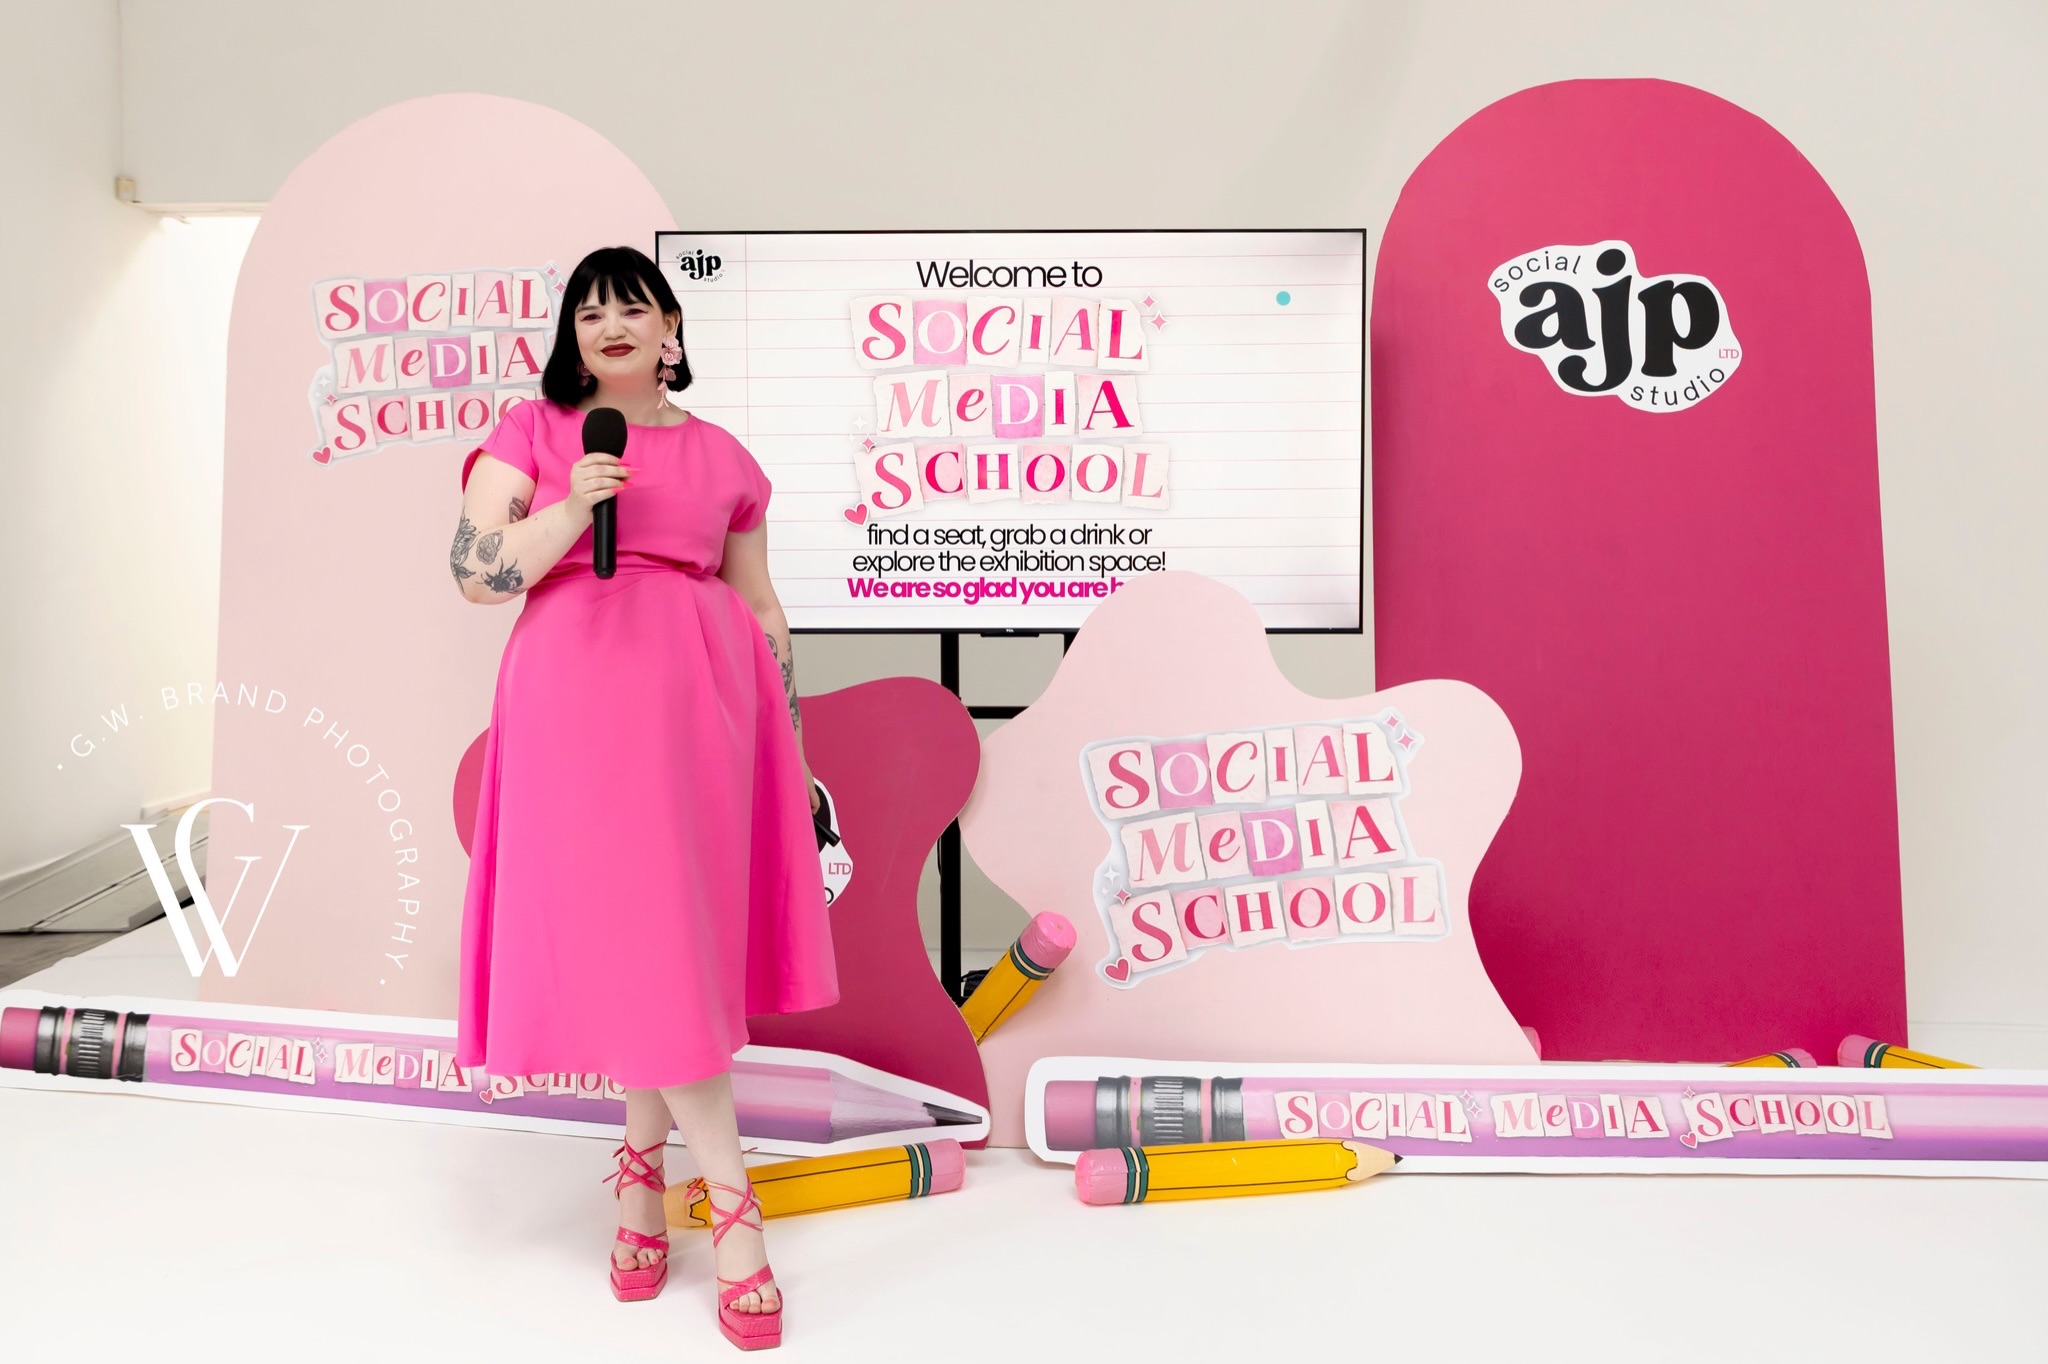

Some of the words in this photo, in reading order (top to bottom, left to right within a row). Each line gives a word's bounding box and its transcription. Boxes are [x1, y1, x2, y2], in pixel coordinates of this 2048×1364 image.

[680, 249, 722, 280] ajp
[916, 259, 1067, 288] Welcome
[1071, 261, 1103, 288] to
[1493, 250, 1582, 293] social
[325, 278, 549, 332] SOCIAL
[1514, 248, 1720, 393] ajp
[862, 302, 1143, 361] SOCIAL
[1718, 348, 1740, 359] LTD
[1630, 368, 1725, 406] studio
[333, 395, 528, 451] SCHO
[871, 451, 1164, 510] SCHOOL
[867, 523, 909, 545] find
[913, 528, 929, 545] a
[933, 525, 987, 549] seat,
[990, 523, 1046, 553] grab
[1050, 528, 1066, 545] a
[1070, 523, 1126, 545] drink
[1129, 528, 1153, 545] or
[852, 550, 935, 579] explore
[938, 550, 976, 572] the
[979, 549, 1085, 572] exhibition
[1089, 551, 1166, 579] space!
[847, 577, 889, 598] We
[890, 581, 931, 598] are
[933, 581, 962, 598] so
[963, 576, 1017, 606] glad
[1019, 581, 1066, 605] you
[1067, 581, 1108, 598] are
[1105, 731, 1394, 809] SOCIAL
[828, 862, 852, 875] LTD
[1131, 876, 1436, 962] SCHOOL
[175, 1033, 313, 1077] SOCIAL
[1284, 1095, 1467, 1135] SOCIAL
[1696, 1098, 1886, 1137] SCHOOL
